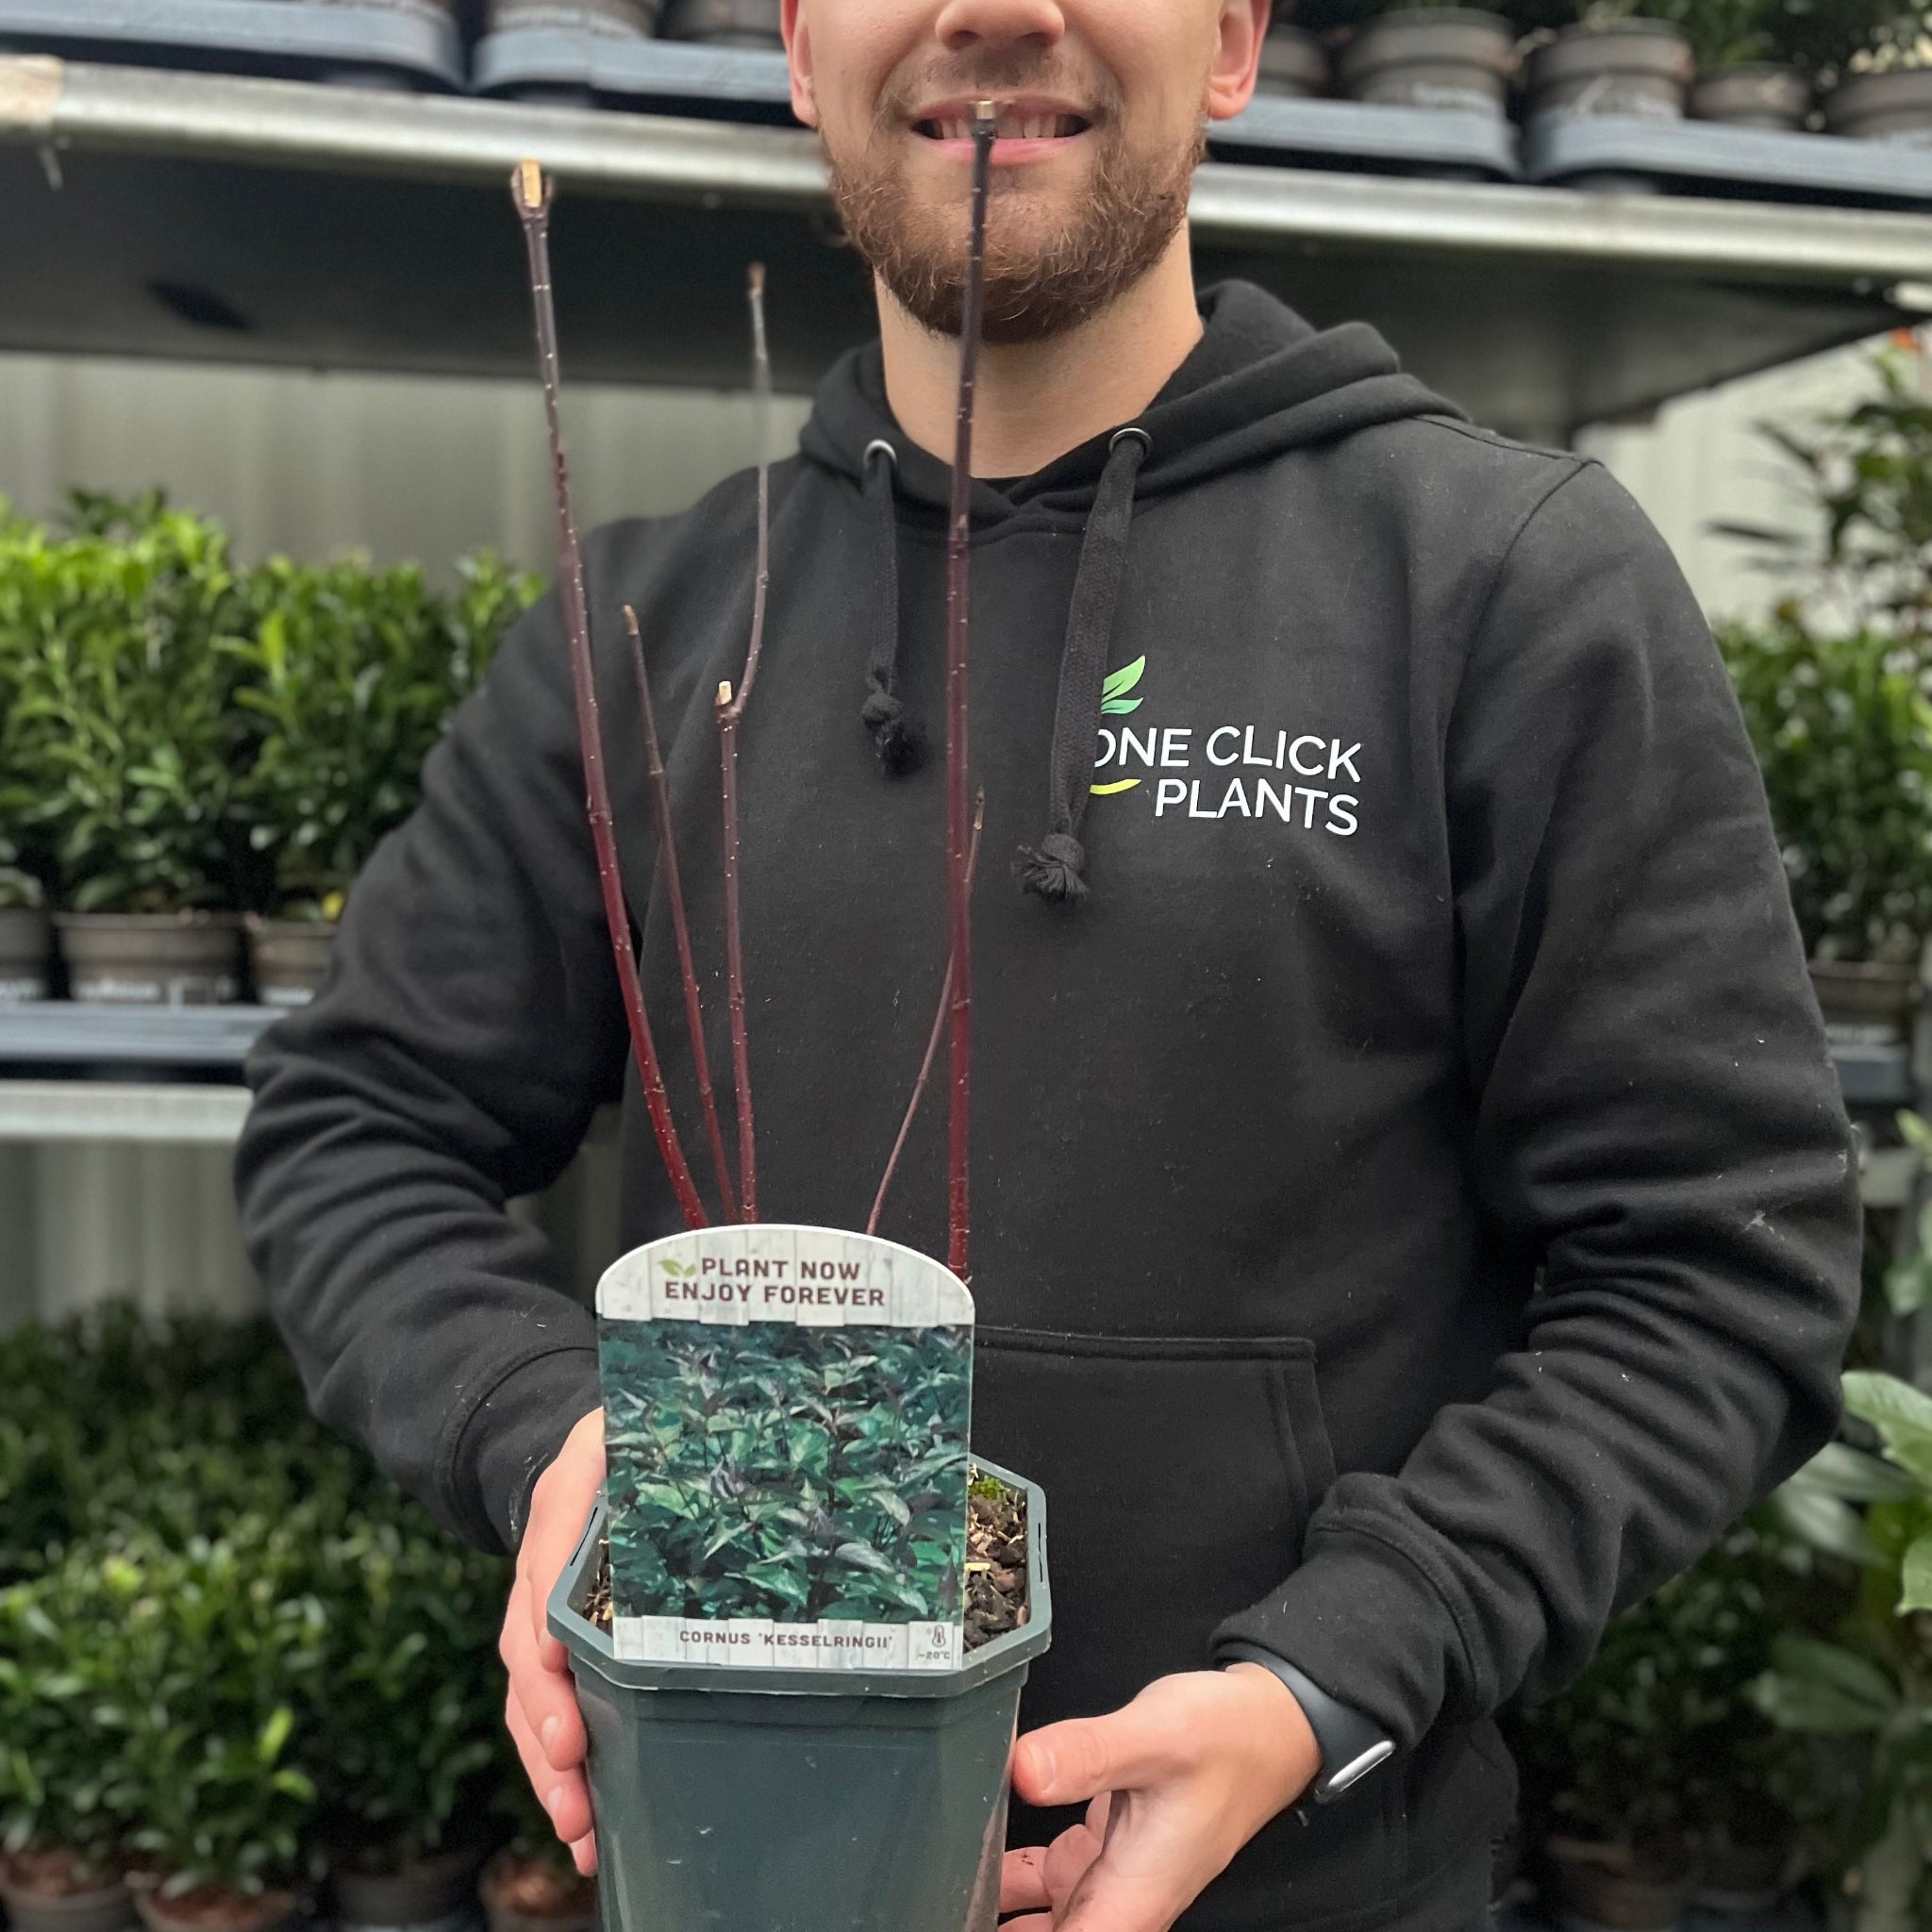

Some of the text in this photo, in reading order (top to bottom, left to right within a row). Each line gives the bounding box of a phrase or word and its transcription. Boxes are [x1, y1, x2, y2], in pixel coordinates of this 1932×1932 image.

[1206, 724, 1361, 783] CLICK
[1155, 777, 1360, 836] PLANTS
[701, 1257, 861, 1280] PLANT NOW
[665, 1280, 885, 1307] ENJOY FOREVER
[679, 1629, 751, 1644] CORNUS
